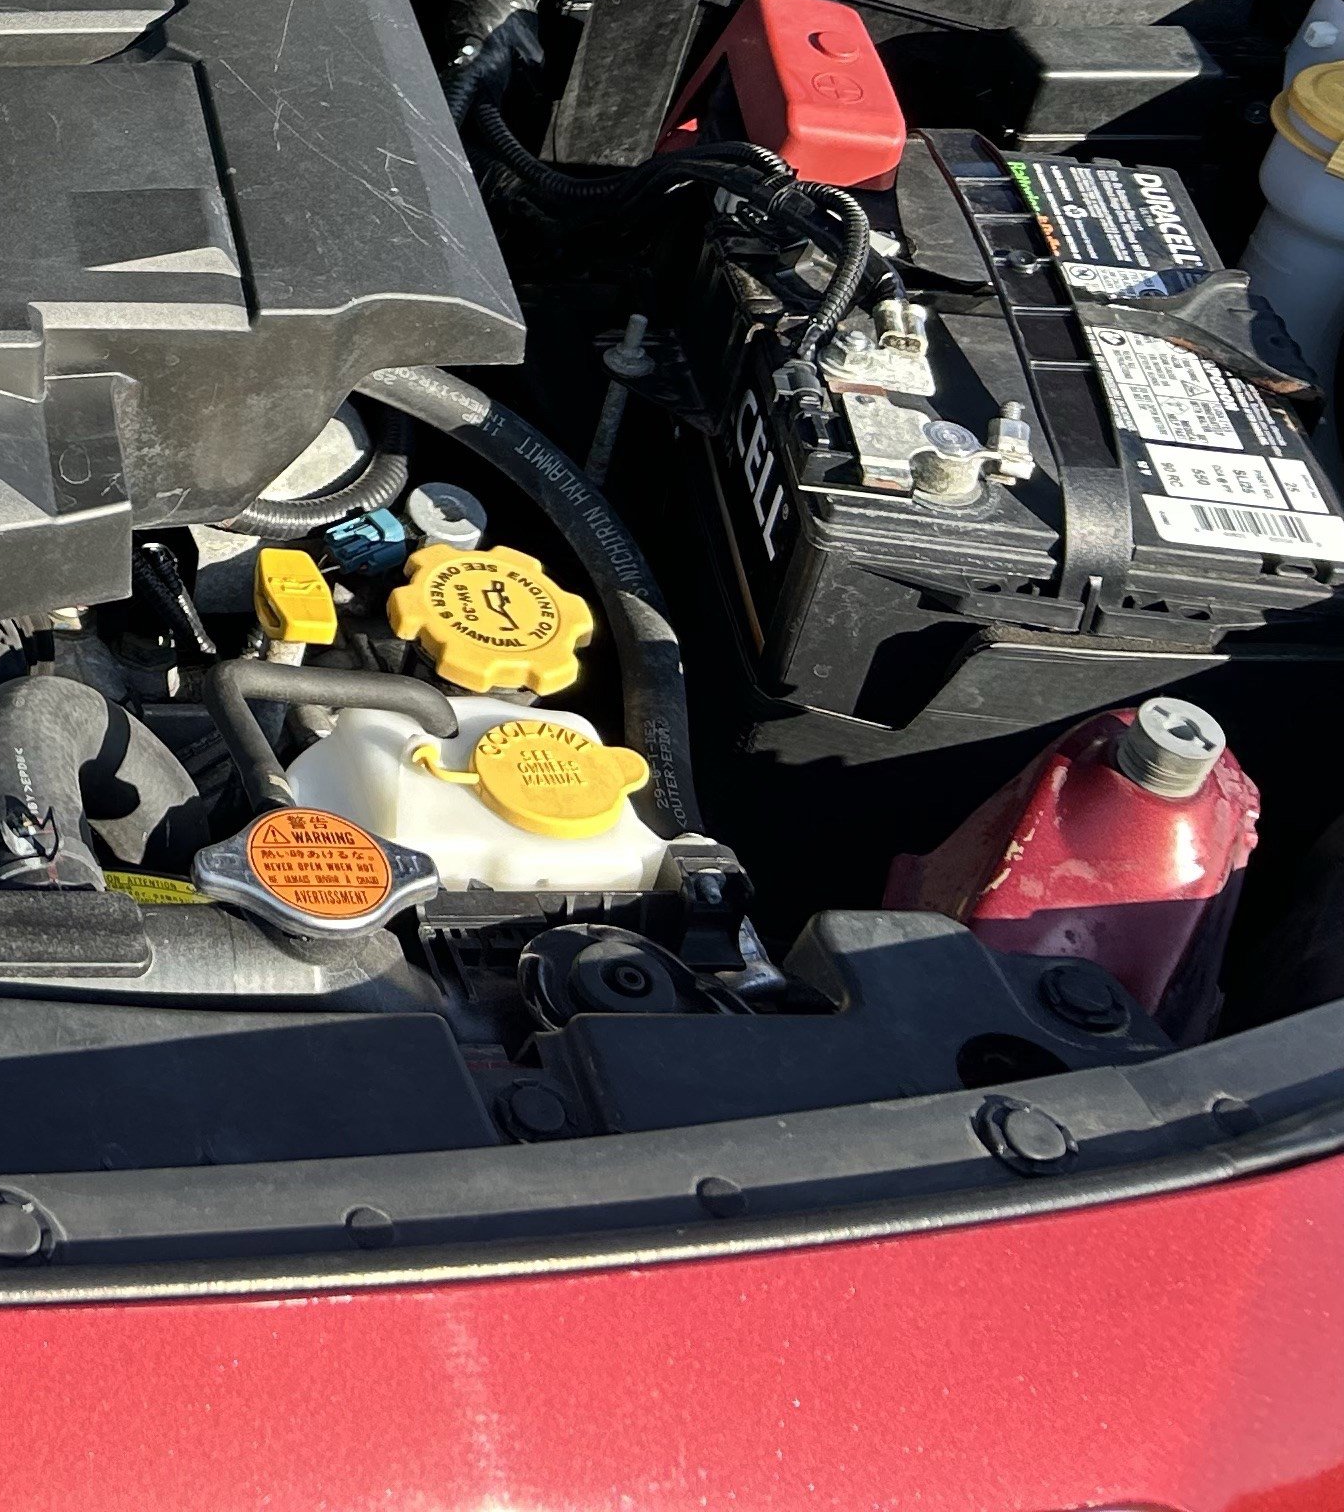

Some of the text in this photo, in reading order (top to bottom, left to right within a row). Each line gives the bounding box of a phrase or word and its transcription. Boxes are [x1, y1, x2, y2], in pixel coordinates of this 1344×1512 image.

[1133, 172, 1202, 267] DURACELL
[1191, 468, 1211, 486] 550
[1283, 481, 1301, 493] 25
[461, 562, 498, 573] SEE
[506, 571, 555, 640] ENGINE OIL
[450, 621, 527, 648] MANUAL
[478, 721, 592, 756] COOLANT
[519, 749, 554, 762] SEE
[522, 772, 587, 787] MANUAL
[291, 831, 356, 846] WARNING
[264, 862, 375, 873] NEVER OPEN WHEN HOT
[294, 890, 369, 905] AVERTISSMENT
